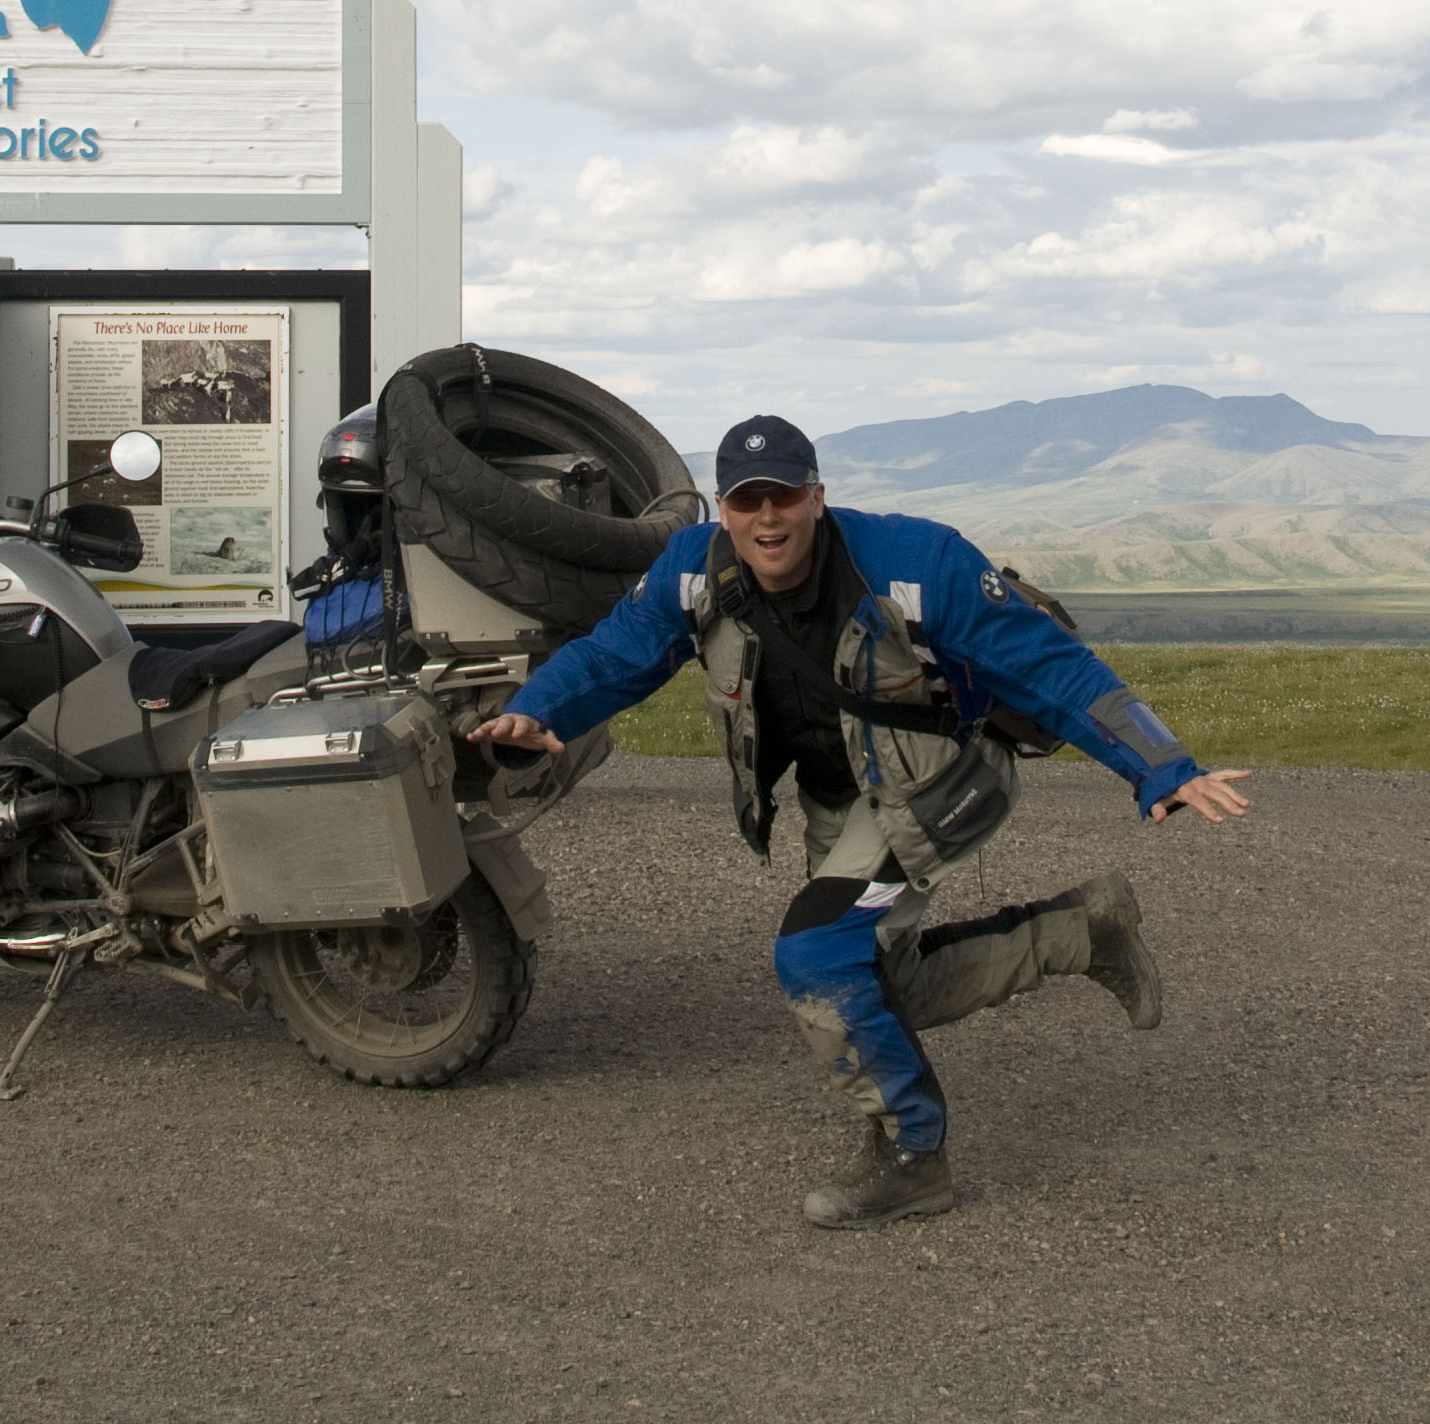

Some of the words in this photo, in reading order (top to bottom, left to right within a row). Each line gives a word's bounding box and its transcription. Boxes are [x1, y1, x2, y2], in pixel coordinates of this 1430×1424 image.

[93, 321, 133, 335] There's
[136, 322, 153, 335] No
[155, 321, 186, 335] Place
[188, 321, 211, 335] Like
[213, 321, 249, 335] Home
[383, 568, 395, 611] BMW
